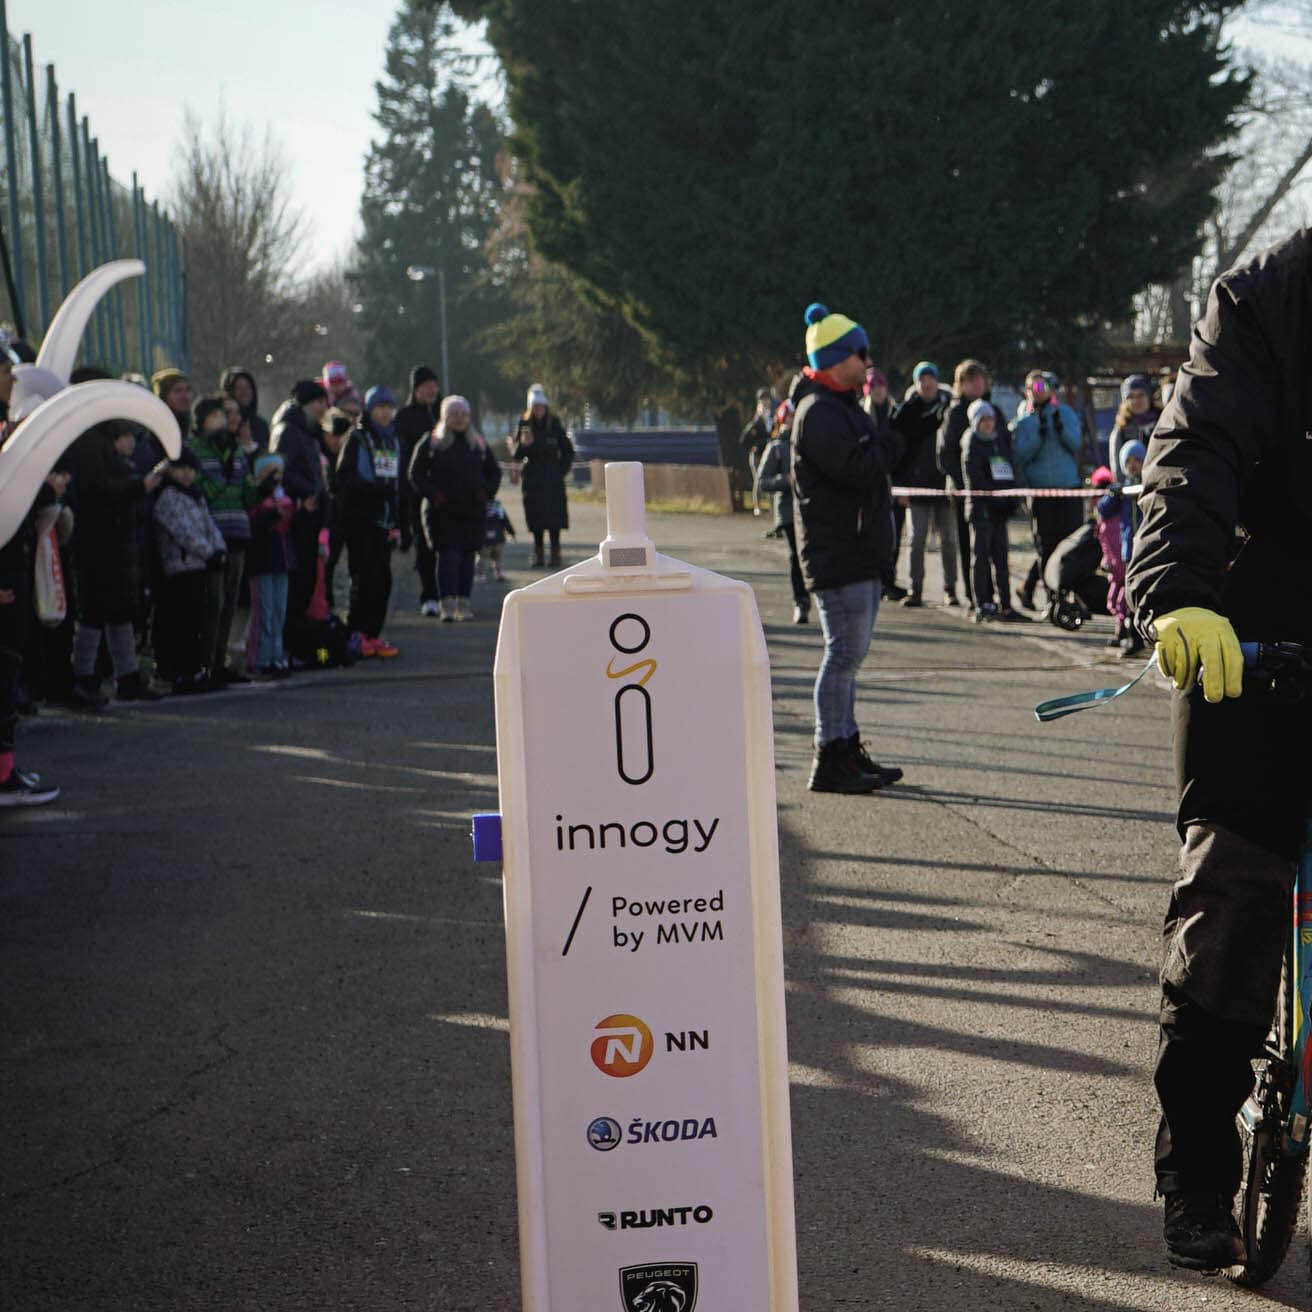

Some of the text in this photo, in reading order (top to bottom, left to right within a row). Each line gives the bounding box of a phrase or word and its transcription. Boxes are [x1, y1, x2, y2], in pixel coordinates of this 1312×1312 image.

[555, 814, 720, 854] innogy
[612, 890, 724, 918] Powered
[613, 920, 724, 953] by MVM
[665, 1029, 709, 1052] NN
[627, 1117, 718, 1145] ŠKODA
[620, 1205, 713, 1230] RUNTO
[626, 1268, 690, 1281] PEUGEOT
